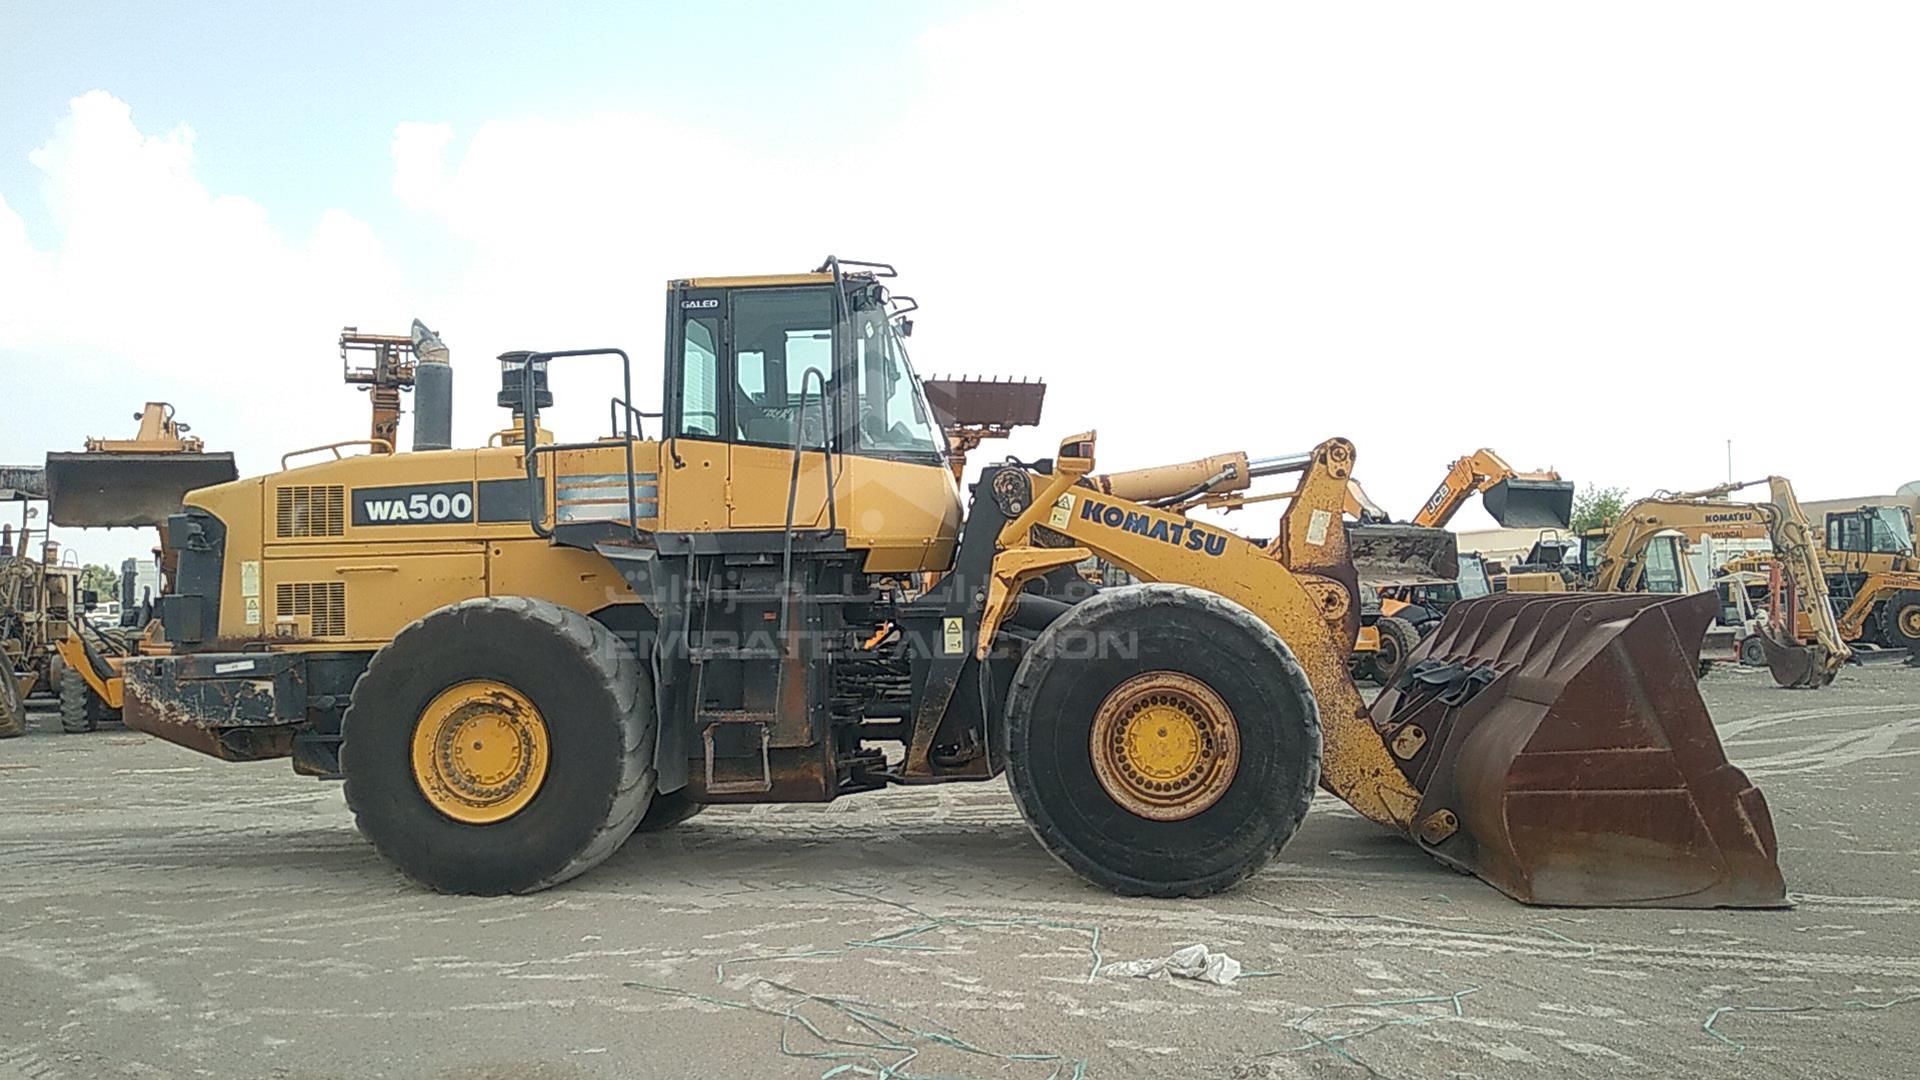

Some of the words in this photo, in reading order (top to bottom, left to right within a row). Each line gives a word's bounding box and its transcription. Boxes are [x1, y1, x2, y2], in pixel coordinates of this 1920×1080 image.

[681, 299, 719, 309] GALEO
[365, 492, 472, 520] WA500
[1427, 484, 1449, 514] JCB
[1080, 498, 1228, 557] KOMATSU
[1705, 512, 1752, 523] KOMATSU
